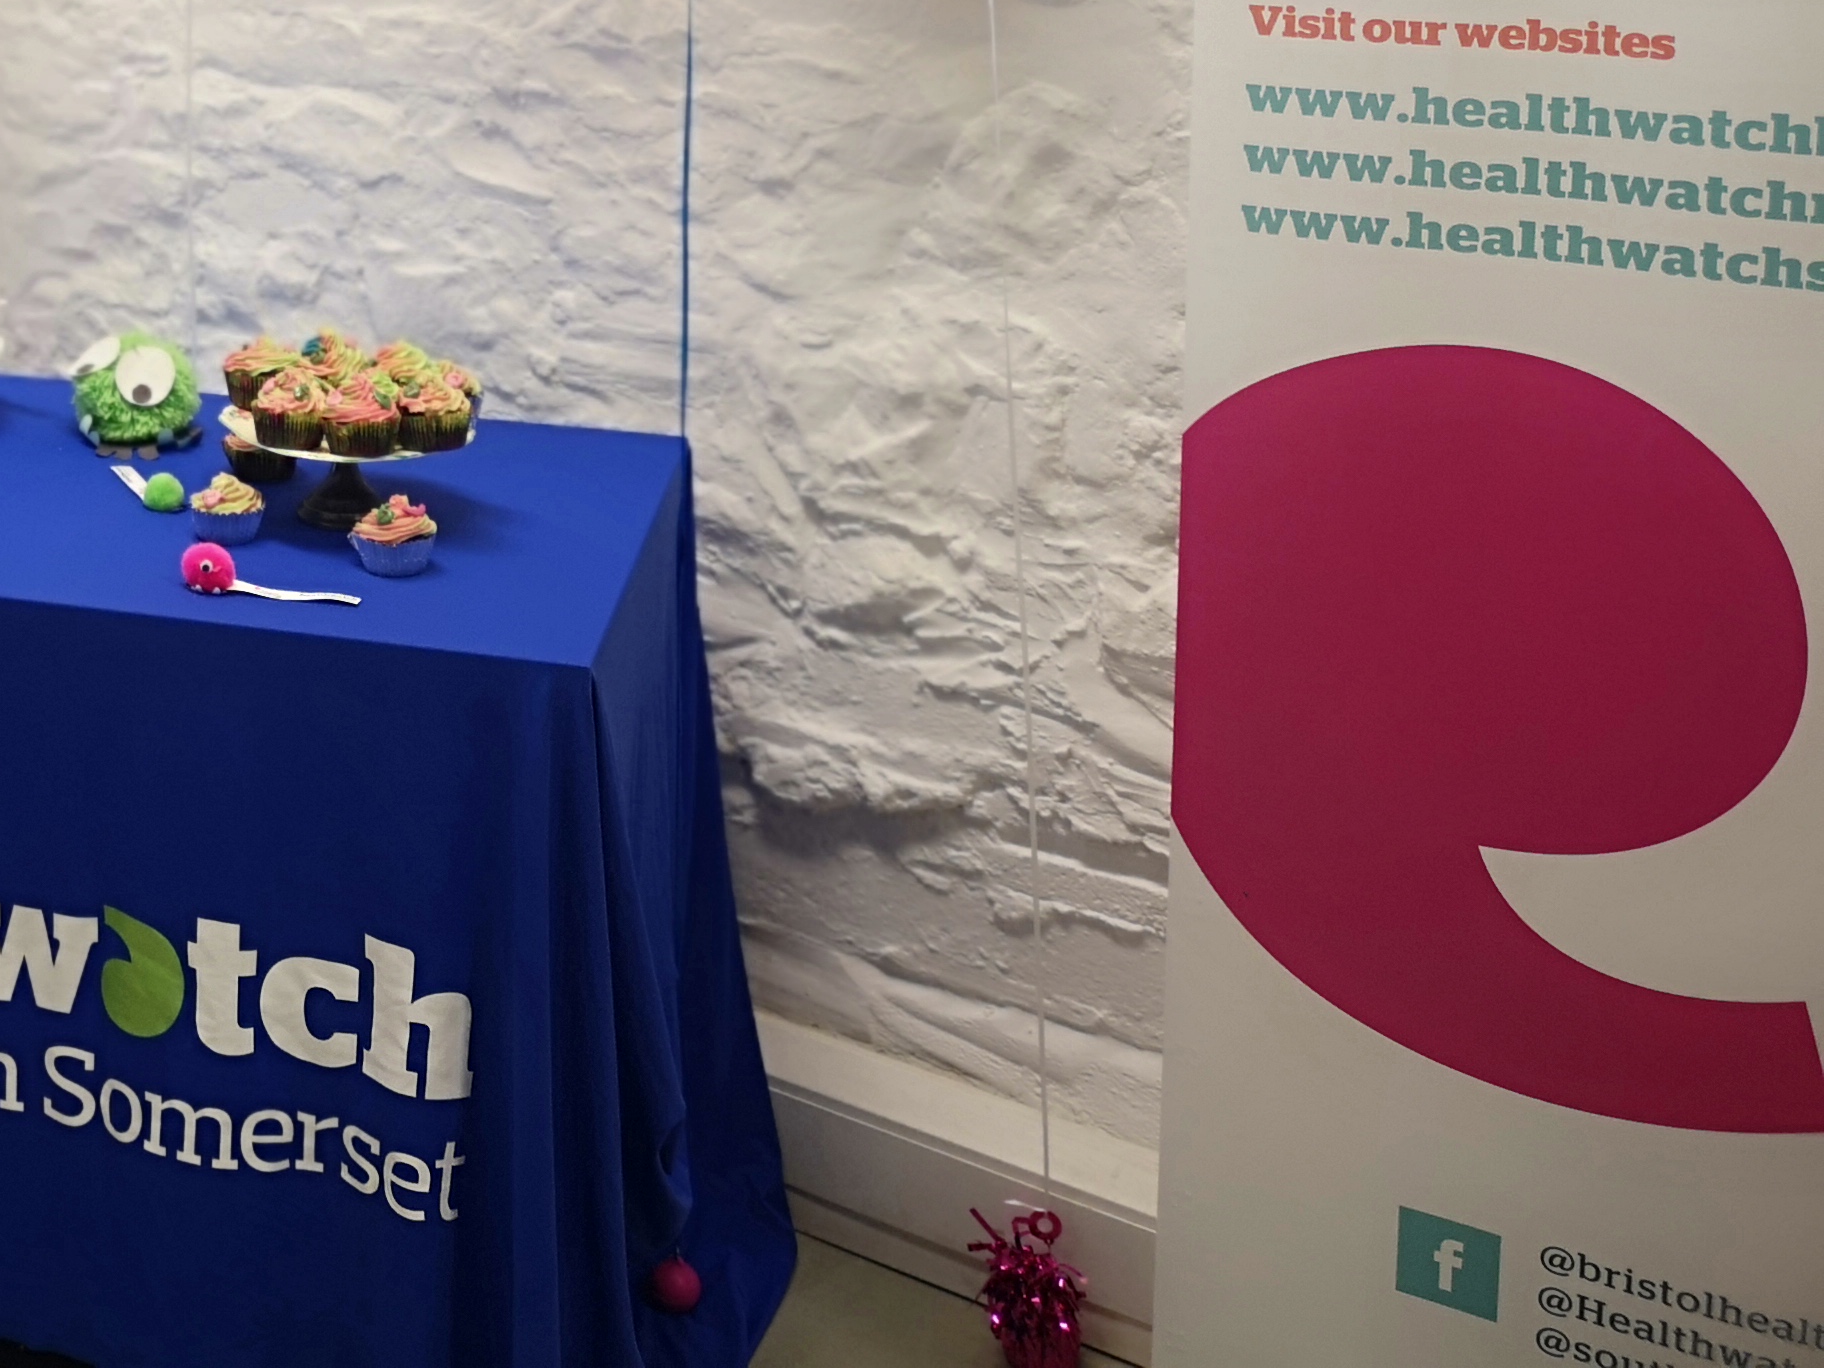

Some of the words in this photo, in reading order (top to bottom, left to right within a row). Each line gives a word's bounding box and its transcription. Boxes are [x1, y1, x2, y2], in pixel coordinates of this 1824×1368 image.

[1248, 4, 1355, 43] Visit
[1362, 17, 1447, 48] our
[1455, 19, 1676, 60] websites
[1246, 83, 1824, 156] www.healthwatch
[42, 1045, 465, 1222] Somerset
